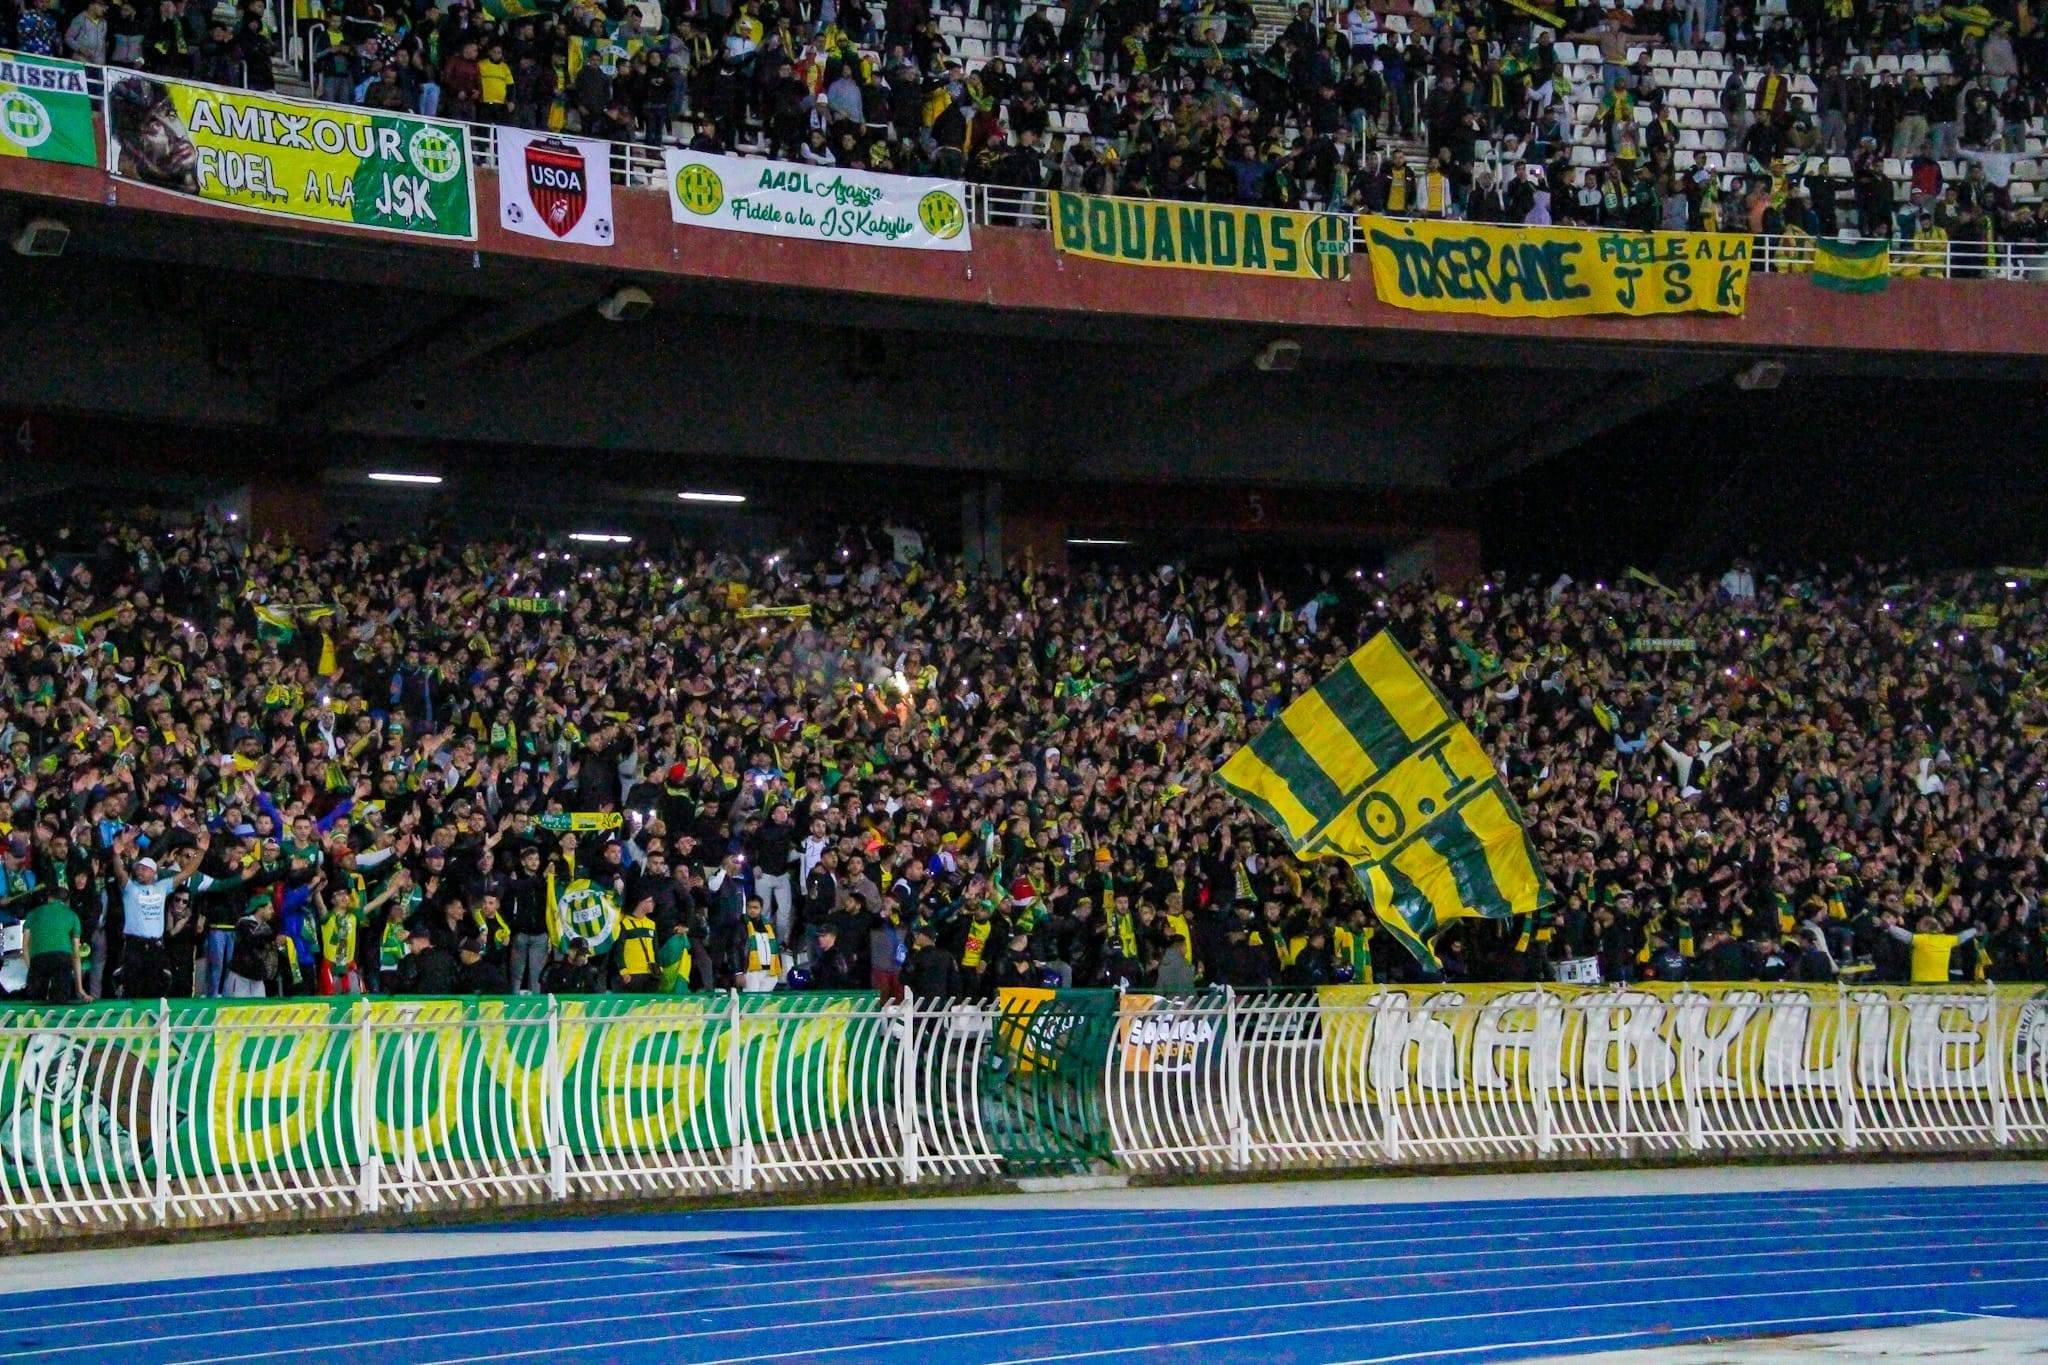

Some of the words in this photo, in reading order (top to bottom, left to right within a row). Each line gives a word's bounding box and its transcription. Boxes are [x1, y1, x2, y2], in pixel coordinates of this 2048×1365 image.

[196, 146, 288, 203] FIDEL
[304, 170, 321, 203] A
[327, 173, 355, 207] LA
[376, 171, 437, 222] JSK
[531, 165, 581, 191] USOA
[759, 168, 814, 194] AADL
[785, 214, 796, 224] a
[799, 207, 815, 227] la
[1058, 191, 1297, 272] BOUANDAS
[1695, 239, 1712, 259] A
[1718, 240, 1746, 261] LA
[1366, 989, 1992, 1090] KABYLIE
